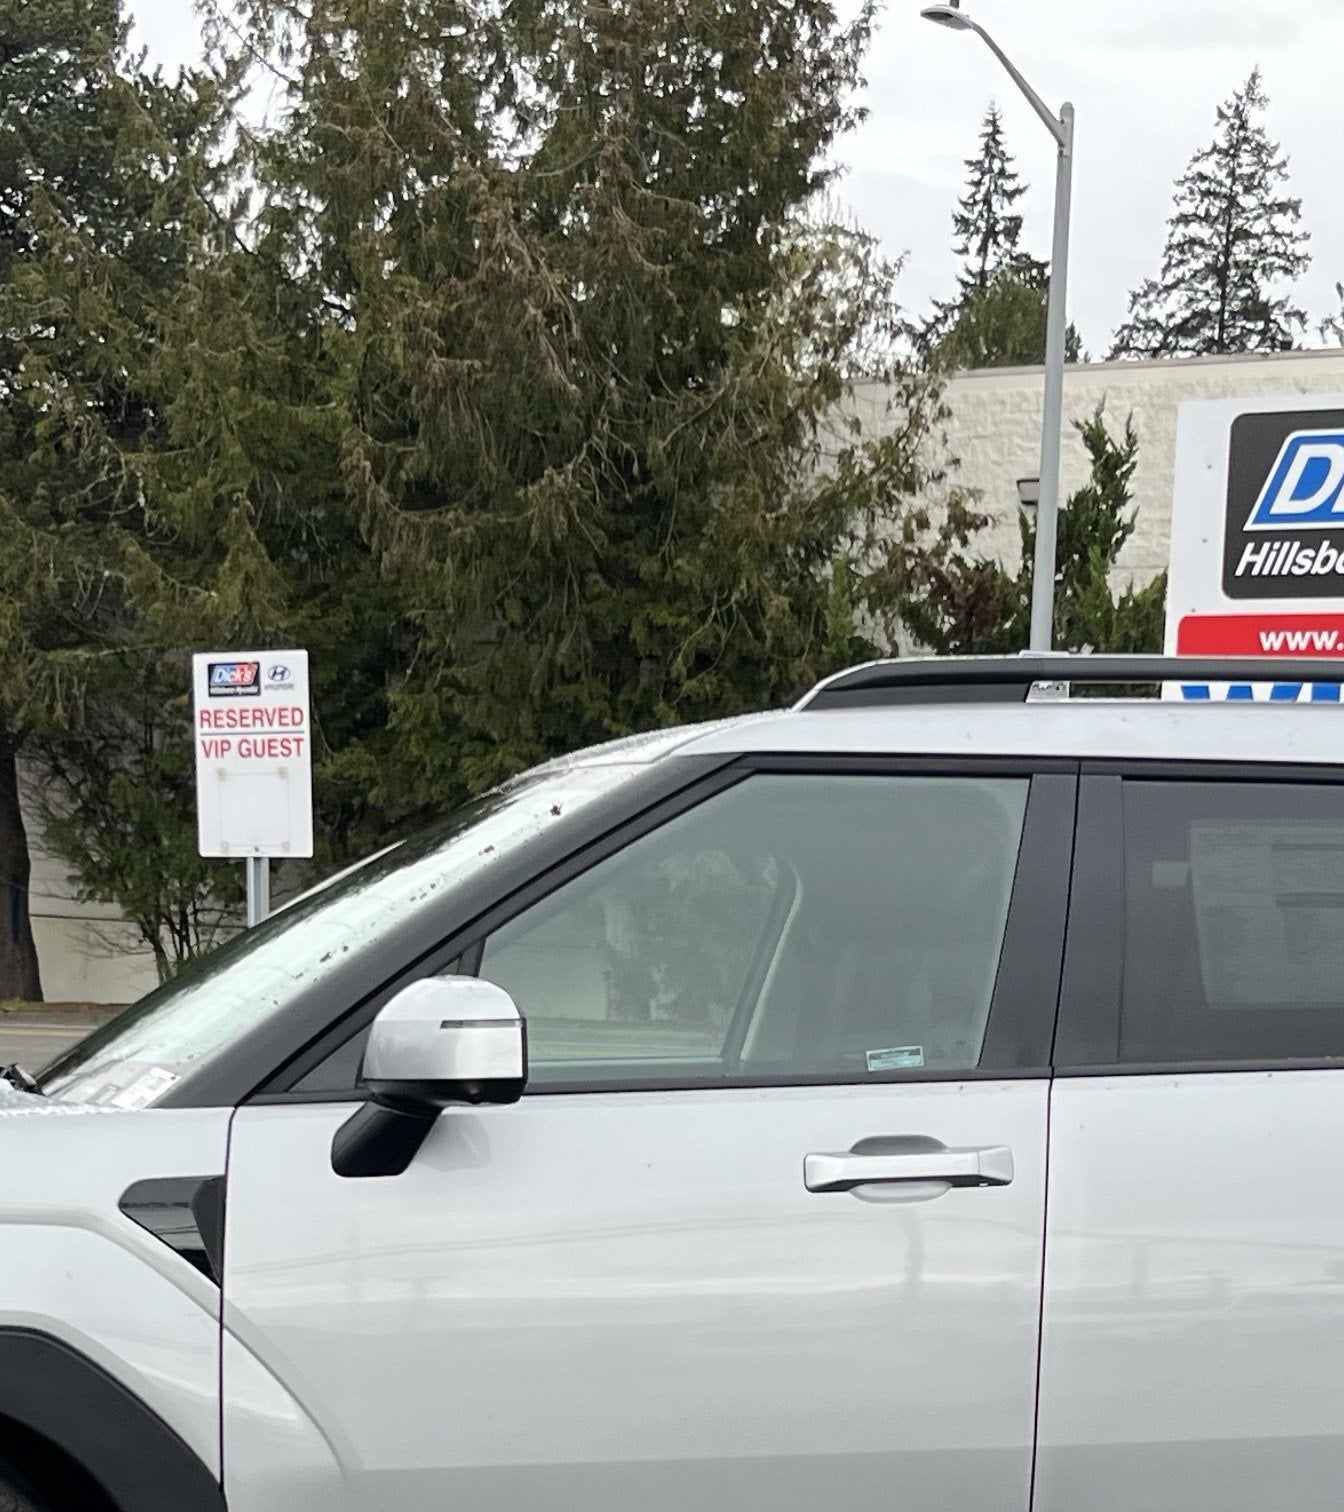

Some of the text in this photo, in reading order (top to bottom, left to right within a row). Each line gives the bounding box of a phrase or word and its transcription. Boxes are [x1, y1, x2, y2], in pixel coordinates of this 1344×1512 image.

[199, 707, 304, 729] RESERVED
[202, 737, 305, 759] VIP GUEST
